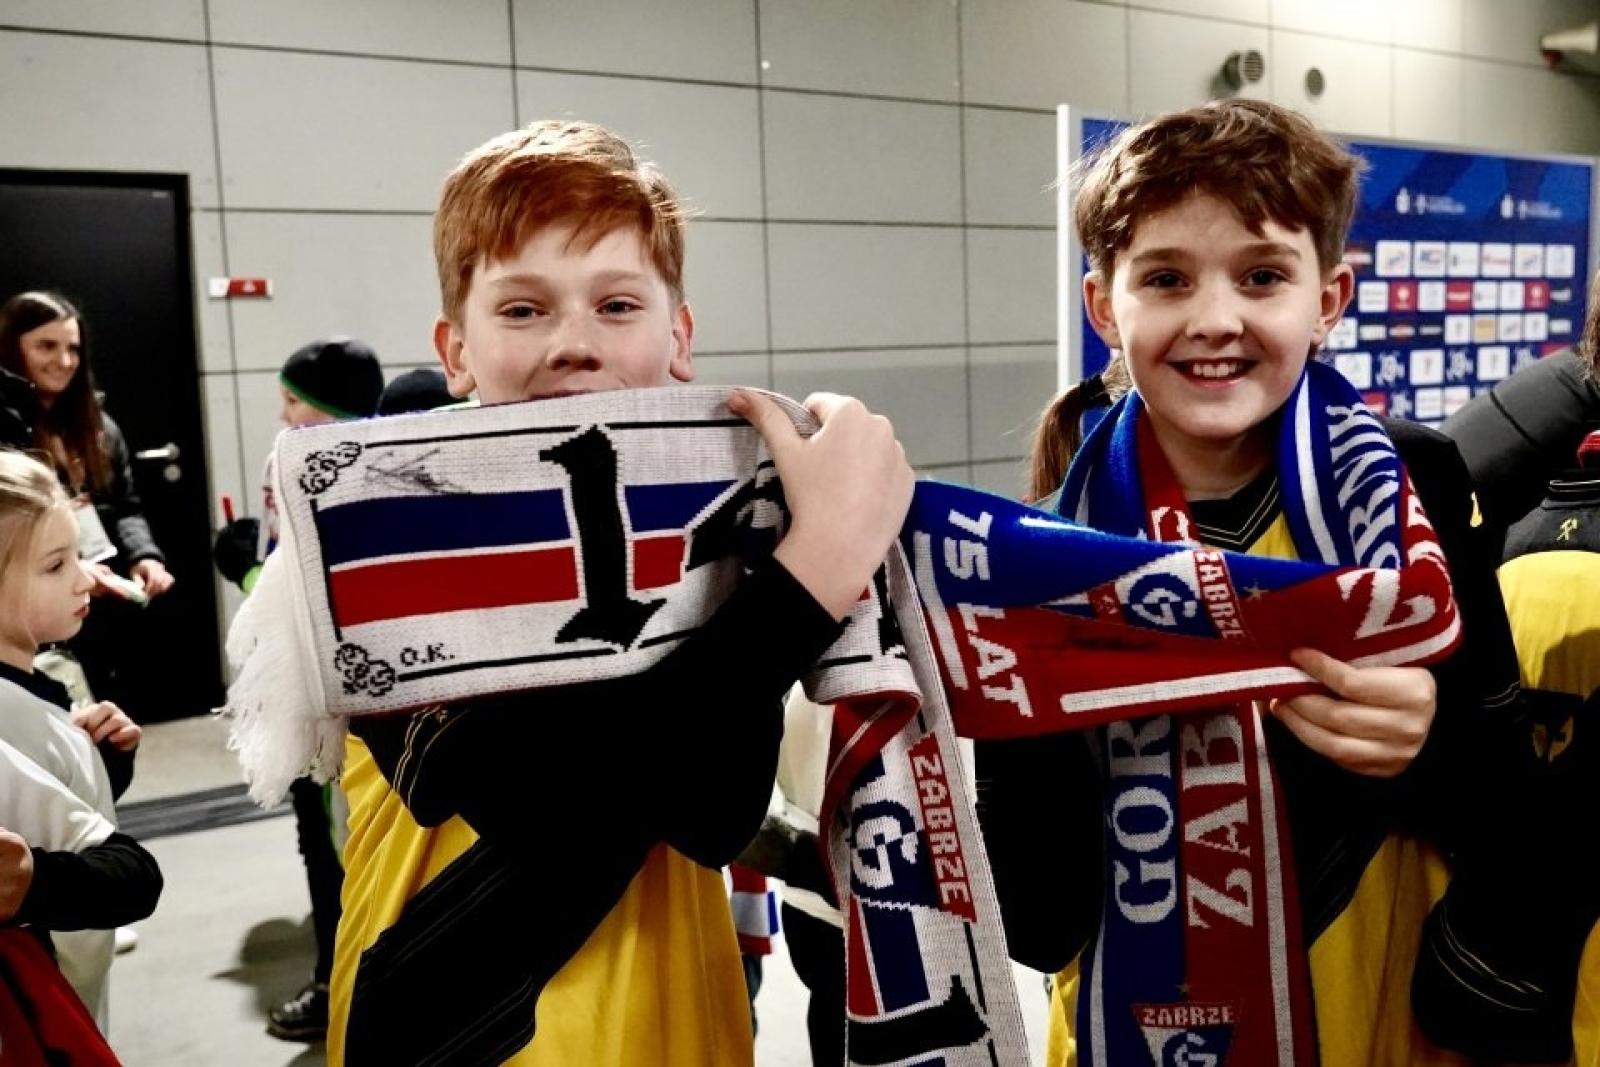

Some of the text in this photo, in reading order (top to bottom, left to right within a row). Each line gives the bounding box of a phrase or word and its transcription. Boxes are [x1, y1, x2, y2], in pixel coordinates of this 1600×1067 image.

[944, 508, 1034, 718] 75 LAT
[1197, 550, 1246, 639] ZABRZE
[912, 752, 970, 904] ZABRZE
[1181, 715, 1254, 928] ZAB
[1143, 1006, 1235, 1026] ZABRZE
